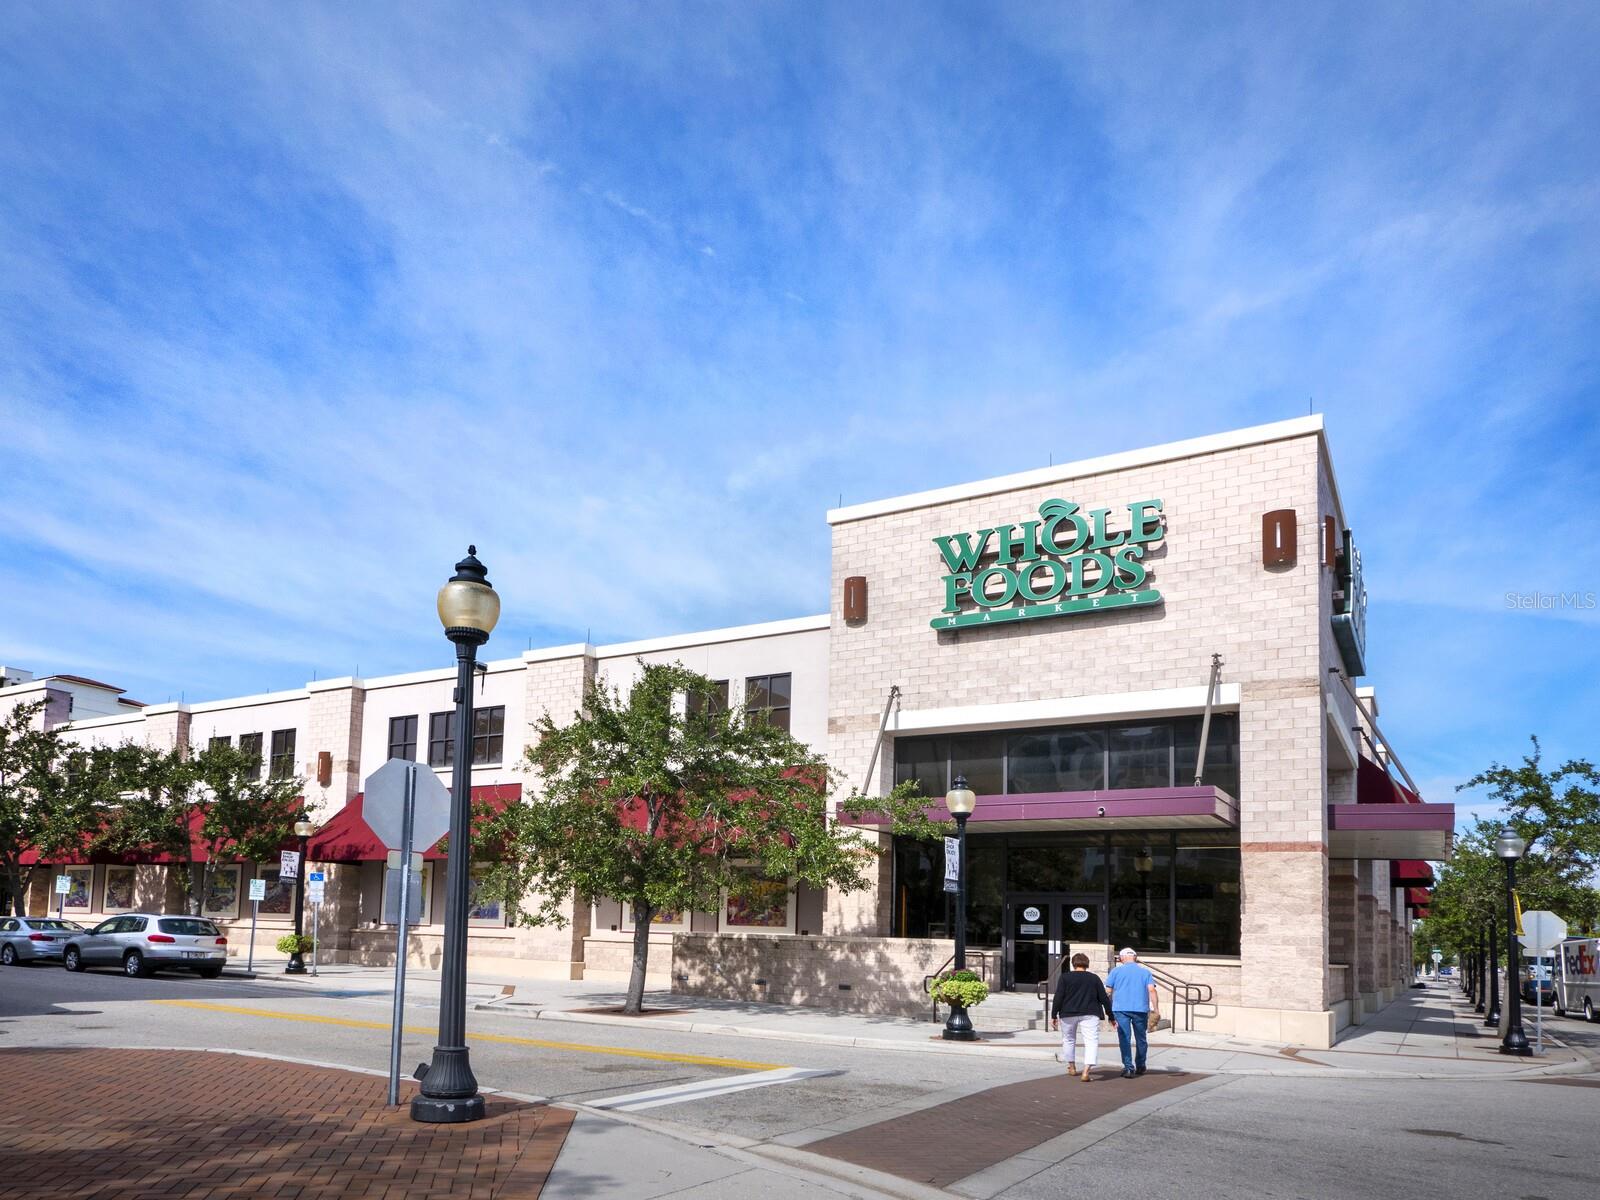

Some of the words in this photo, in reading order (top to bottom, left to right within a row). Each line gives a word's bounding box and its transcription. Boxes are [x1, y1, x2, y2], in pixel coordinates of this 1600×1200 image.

[932, 498, 1164, 574] WHOLE
[941, 546, 1147, 613] FOODS
[947, 593, 1139, 625] MARKET
[1564, 944, 1595, 975] FedEx
